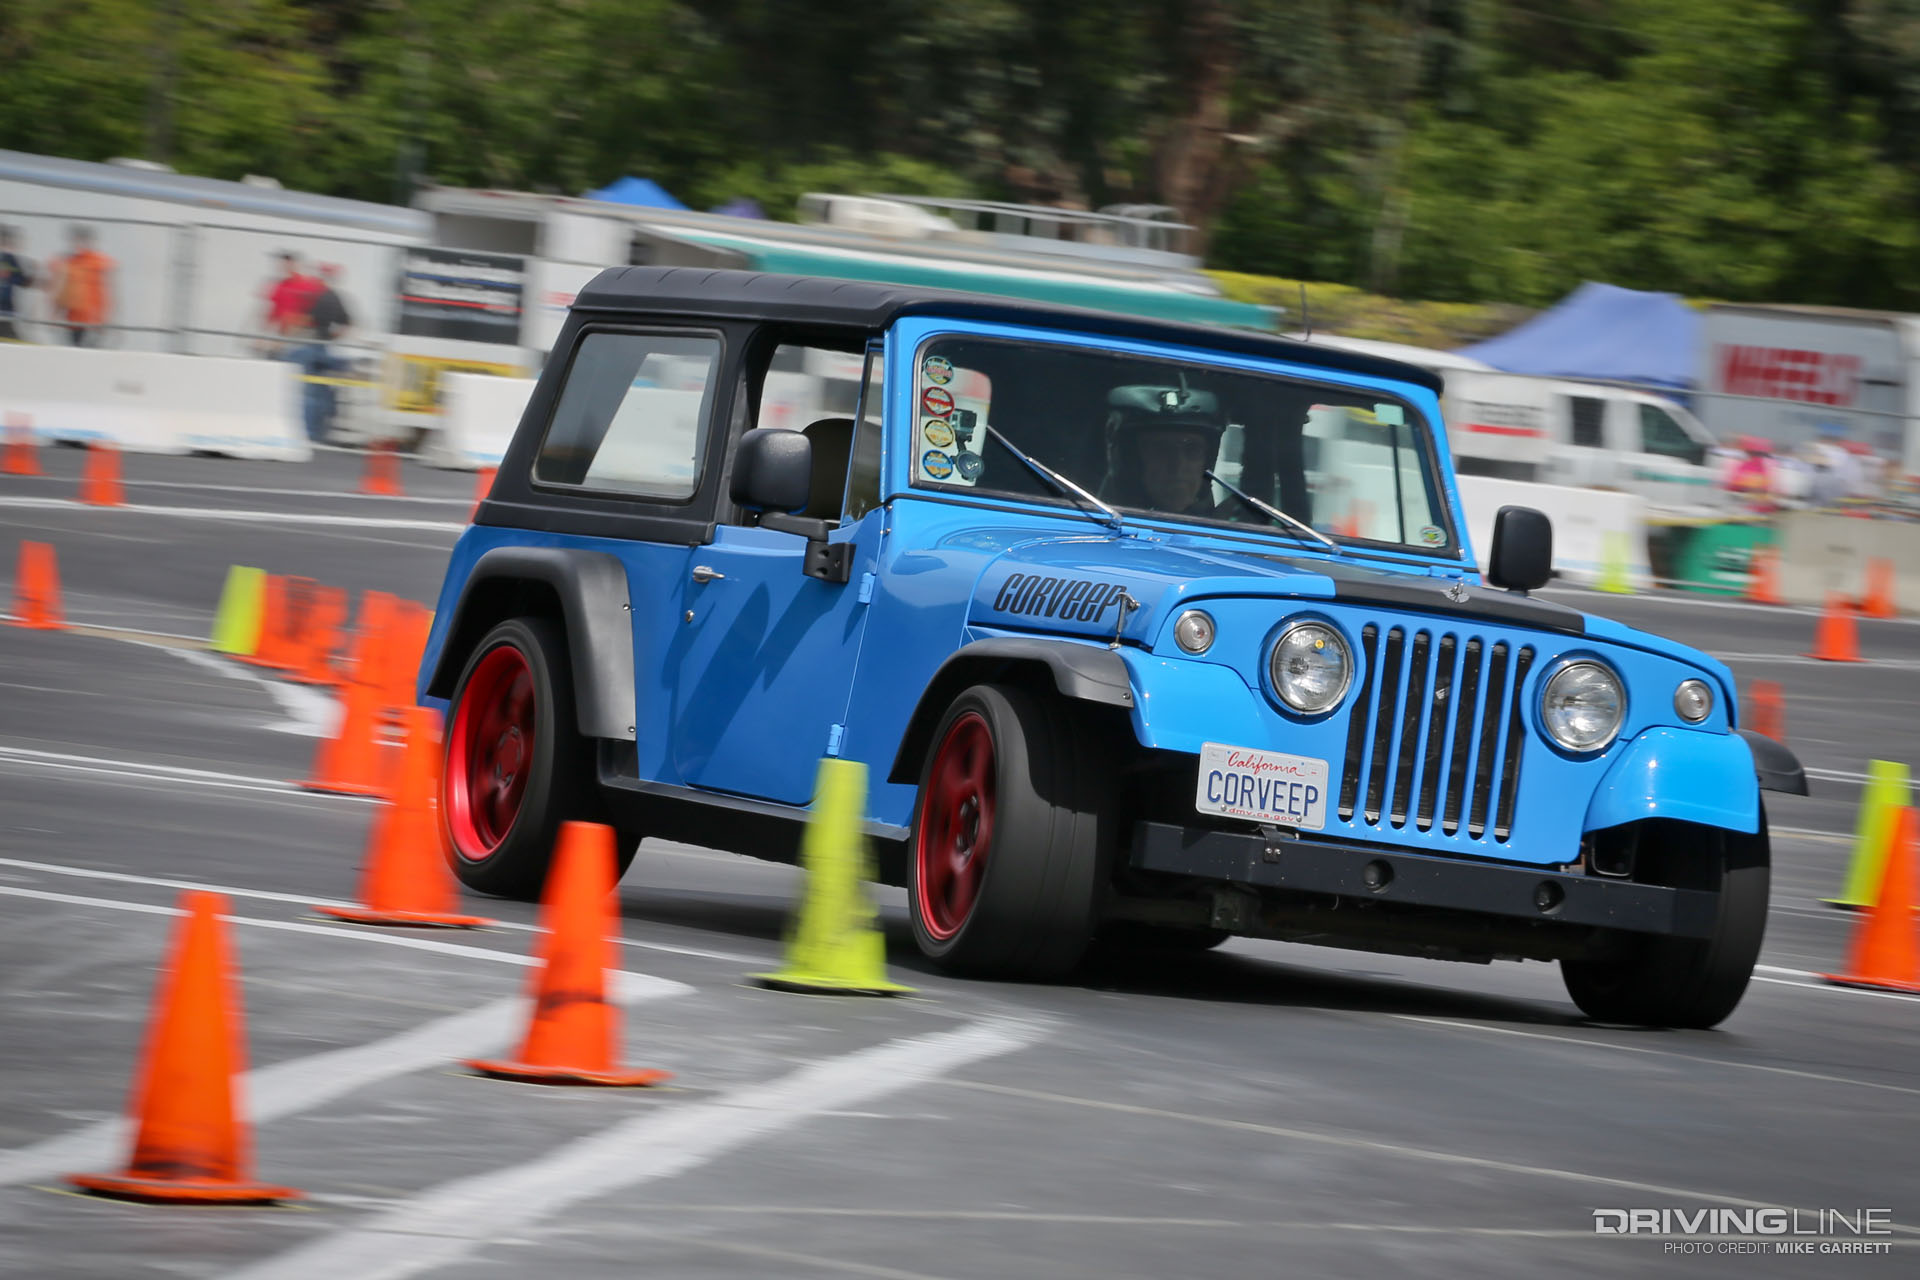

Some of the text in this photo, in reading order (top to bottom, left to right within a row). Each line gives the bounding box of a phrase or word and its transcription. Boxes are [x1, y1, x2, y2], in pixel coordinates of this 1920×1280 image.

[1227, 751, 1306, 776] California
[1207, 770, 1319, 817] CORVEEP
[1228, 807, 1295, 822] dmv.ca.gov
